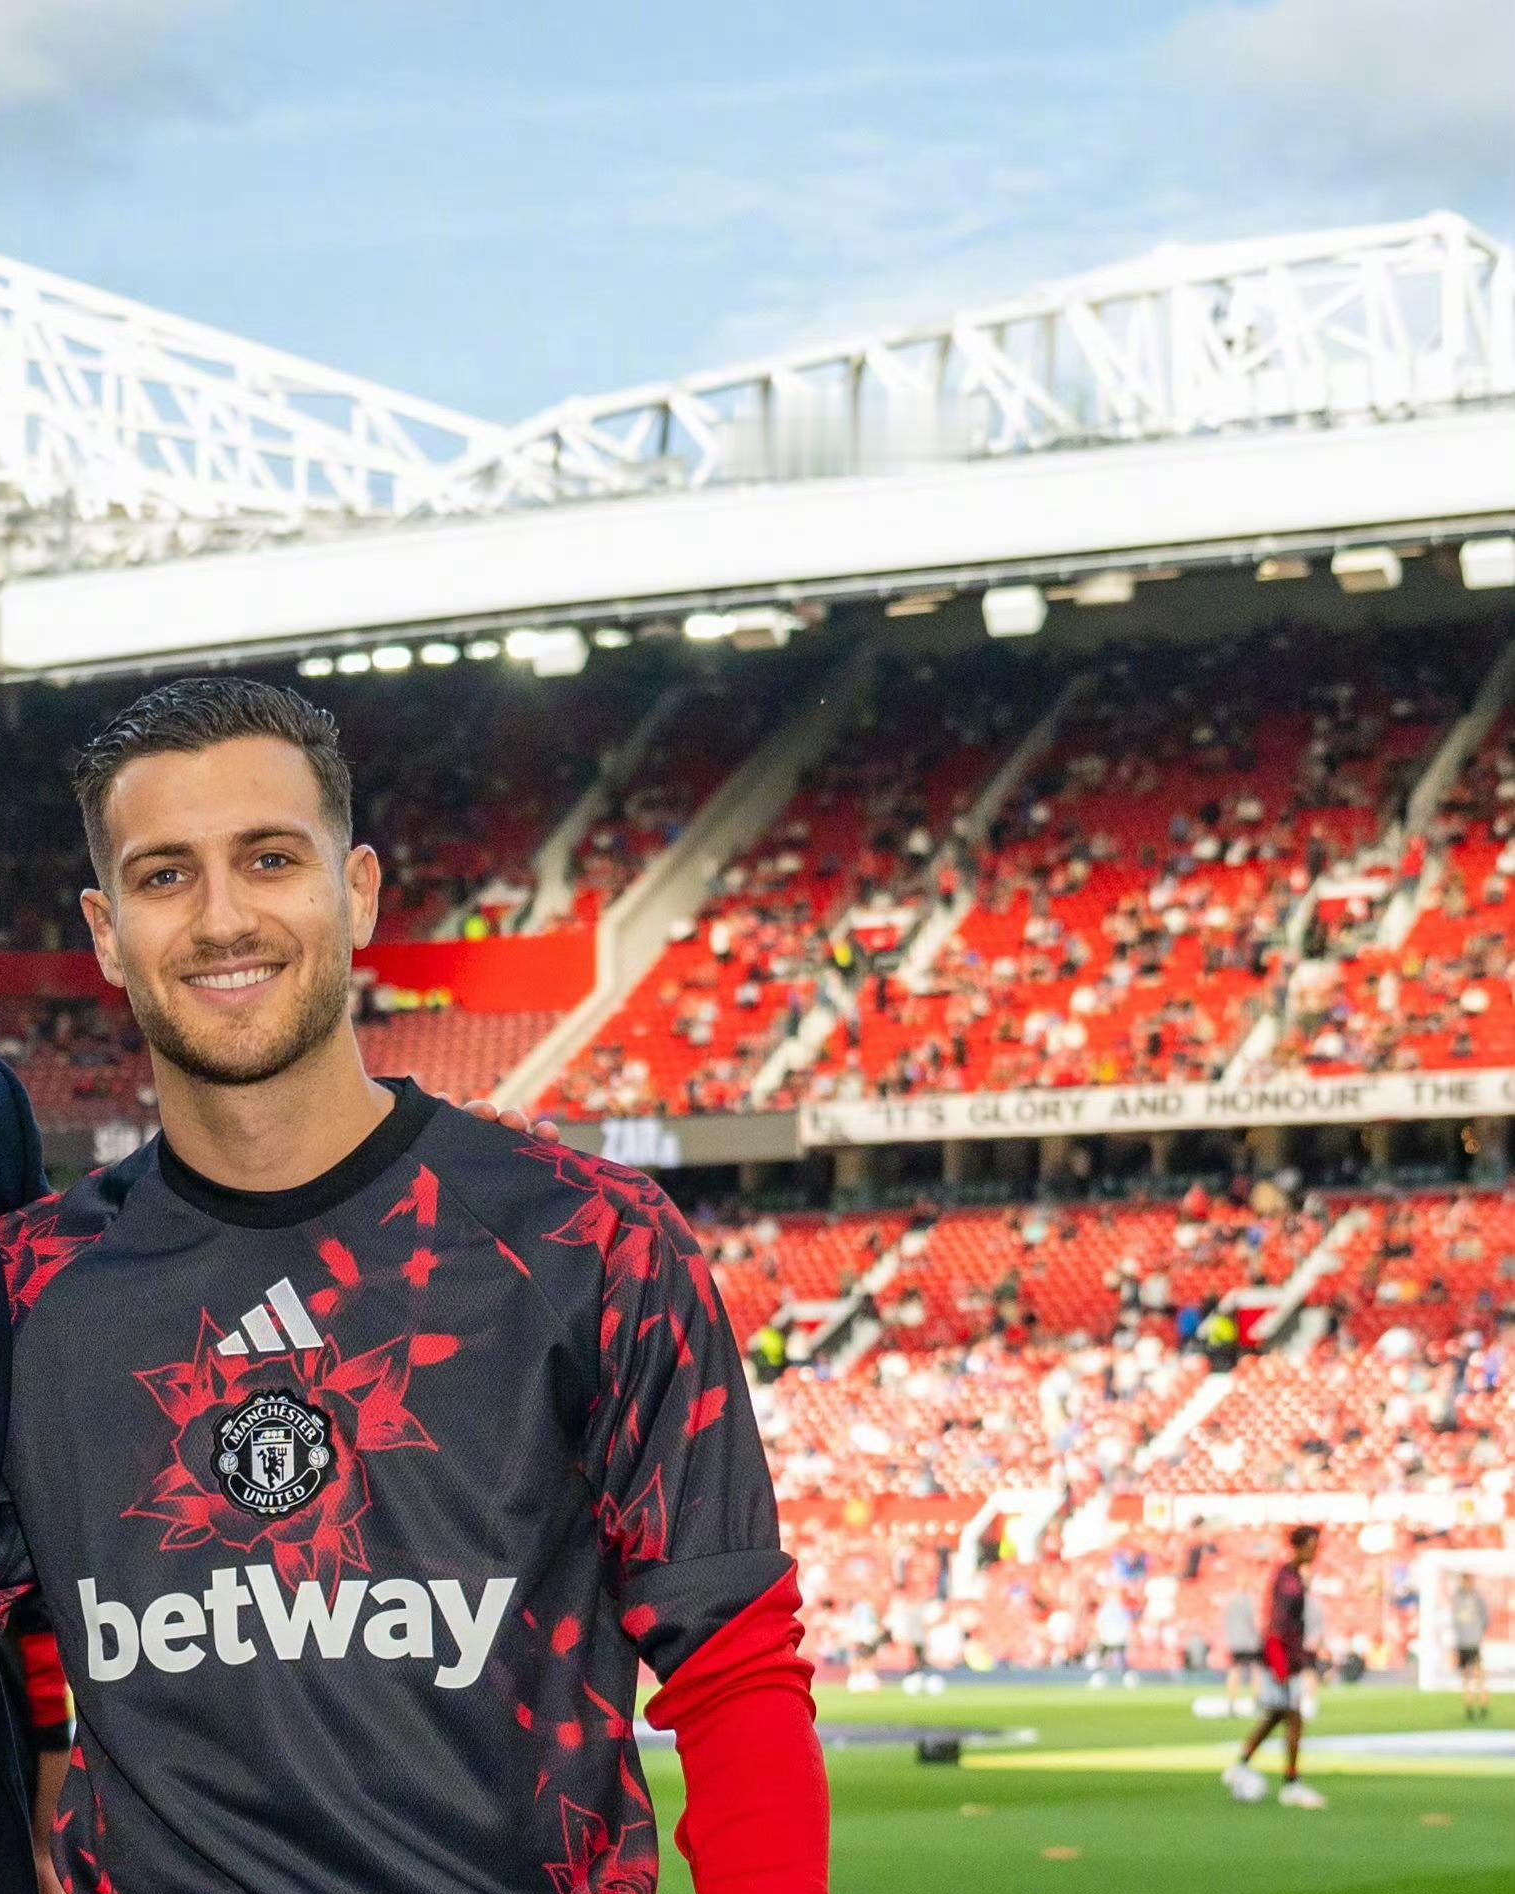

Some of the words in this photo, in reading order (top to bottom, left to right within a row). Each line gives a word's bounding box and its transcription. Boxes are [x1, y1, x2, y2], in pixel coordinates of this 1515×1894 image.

[968, 1098, 1086, 1126] GLORY
[1108, 1092, 1184, 1120] AND
[1409, 1078, 1478, 1106] THE
[229, 1404, 317, 1445] MANCHESTER
[243, 1484, 306, 1506] UNITED
[77, 1564, 518, 1690] betway
